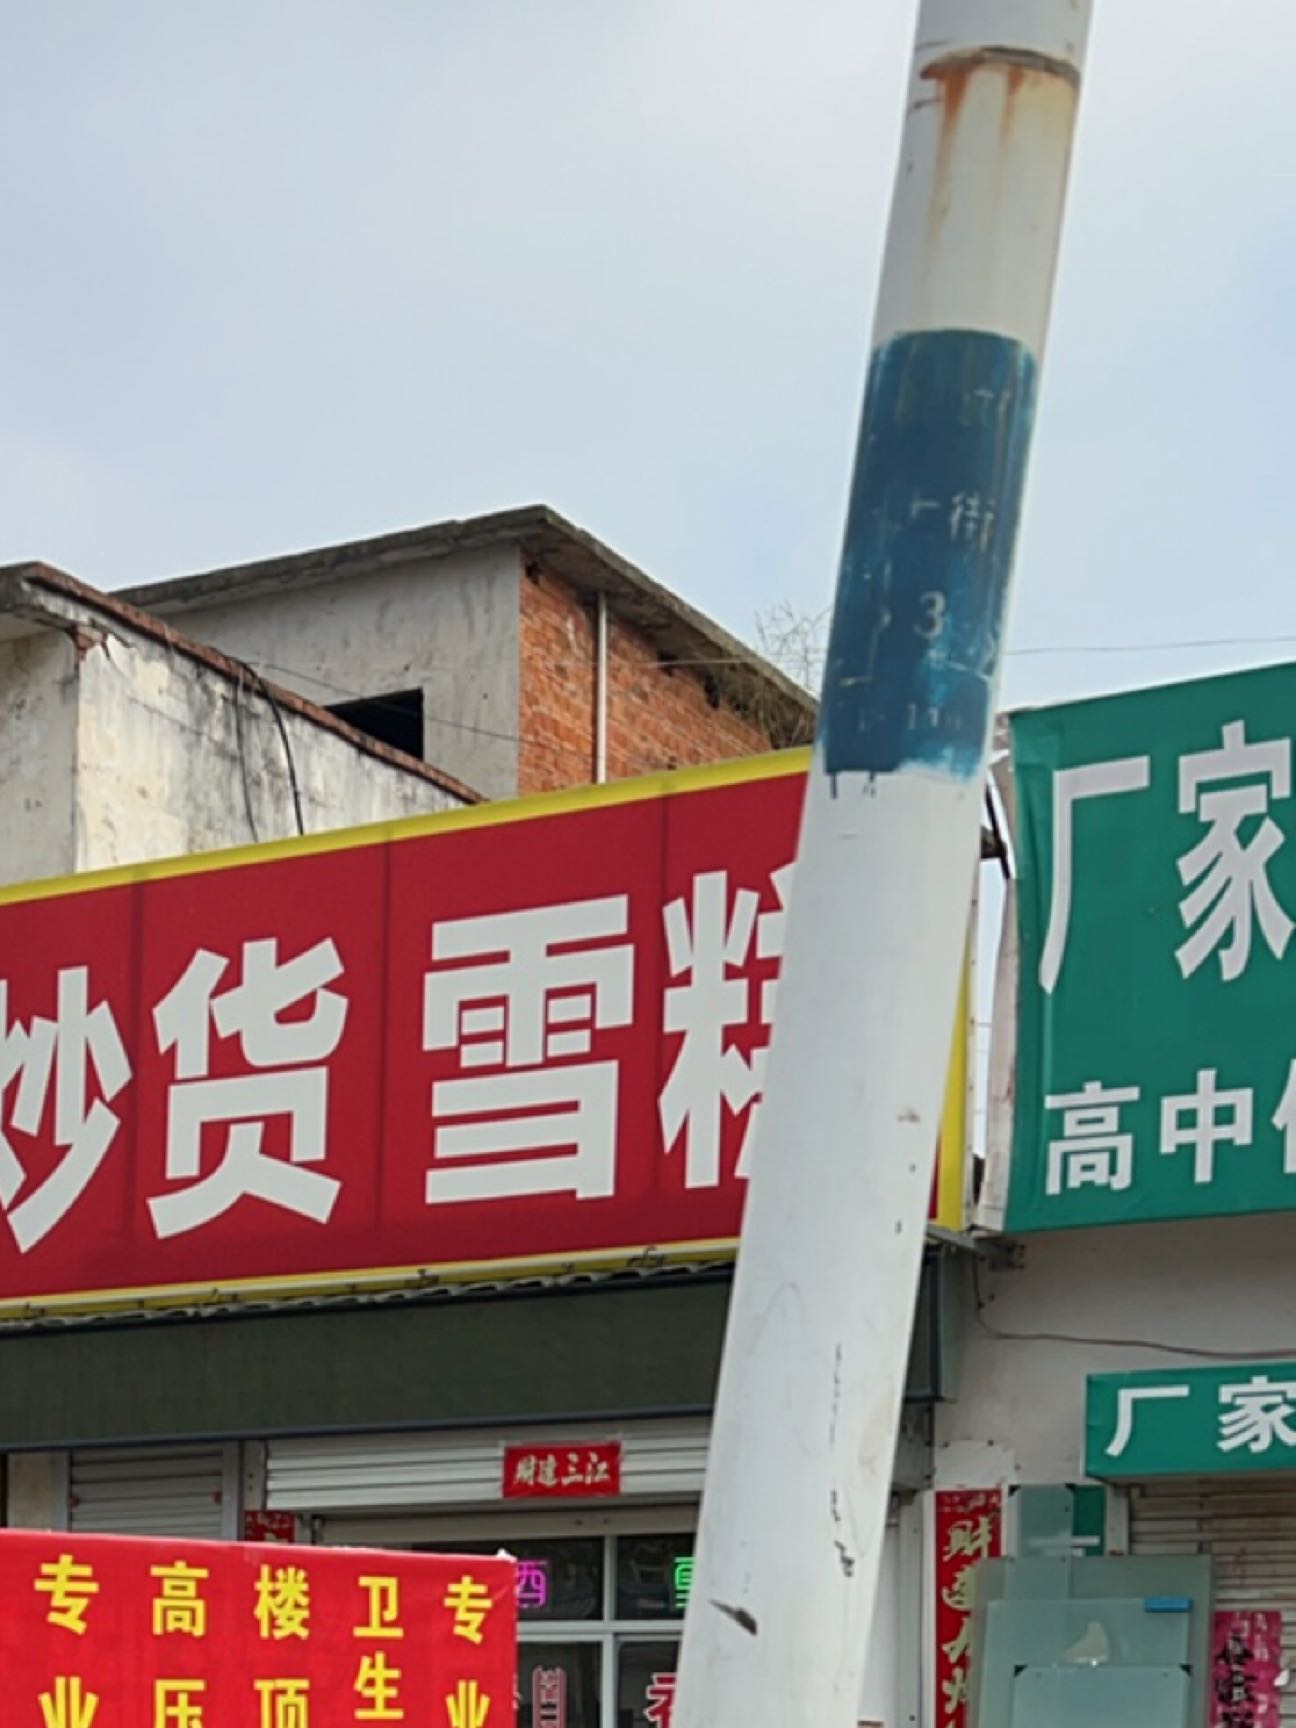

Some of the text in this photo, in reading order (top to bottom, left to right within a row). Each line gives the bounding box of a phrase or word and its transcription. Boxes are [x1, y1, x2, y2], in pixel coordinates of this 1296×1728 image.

[912, 591, 946, 639] 3
[1038, 720, 1296, 995] 厂家
[1044, 1059, 1296, 1196] 高中
[1106, 1375, 1296, 1457] 厂家
